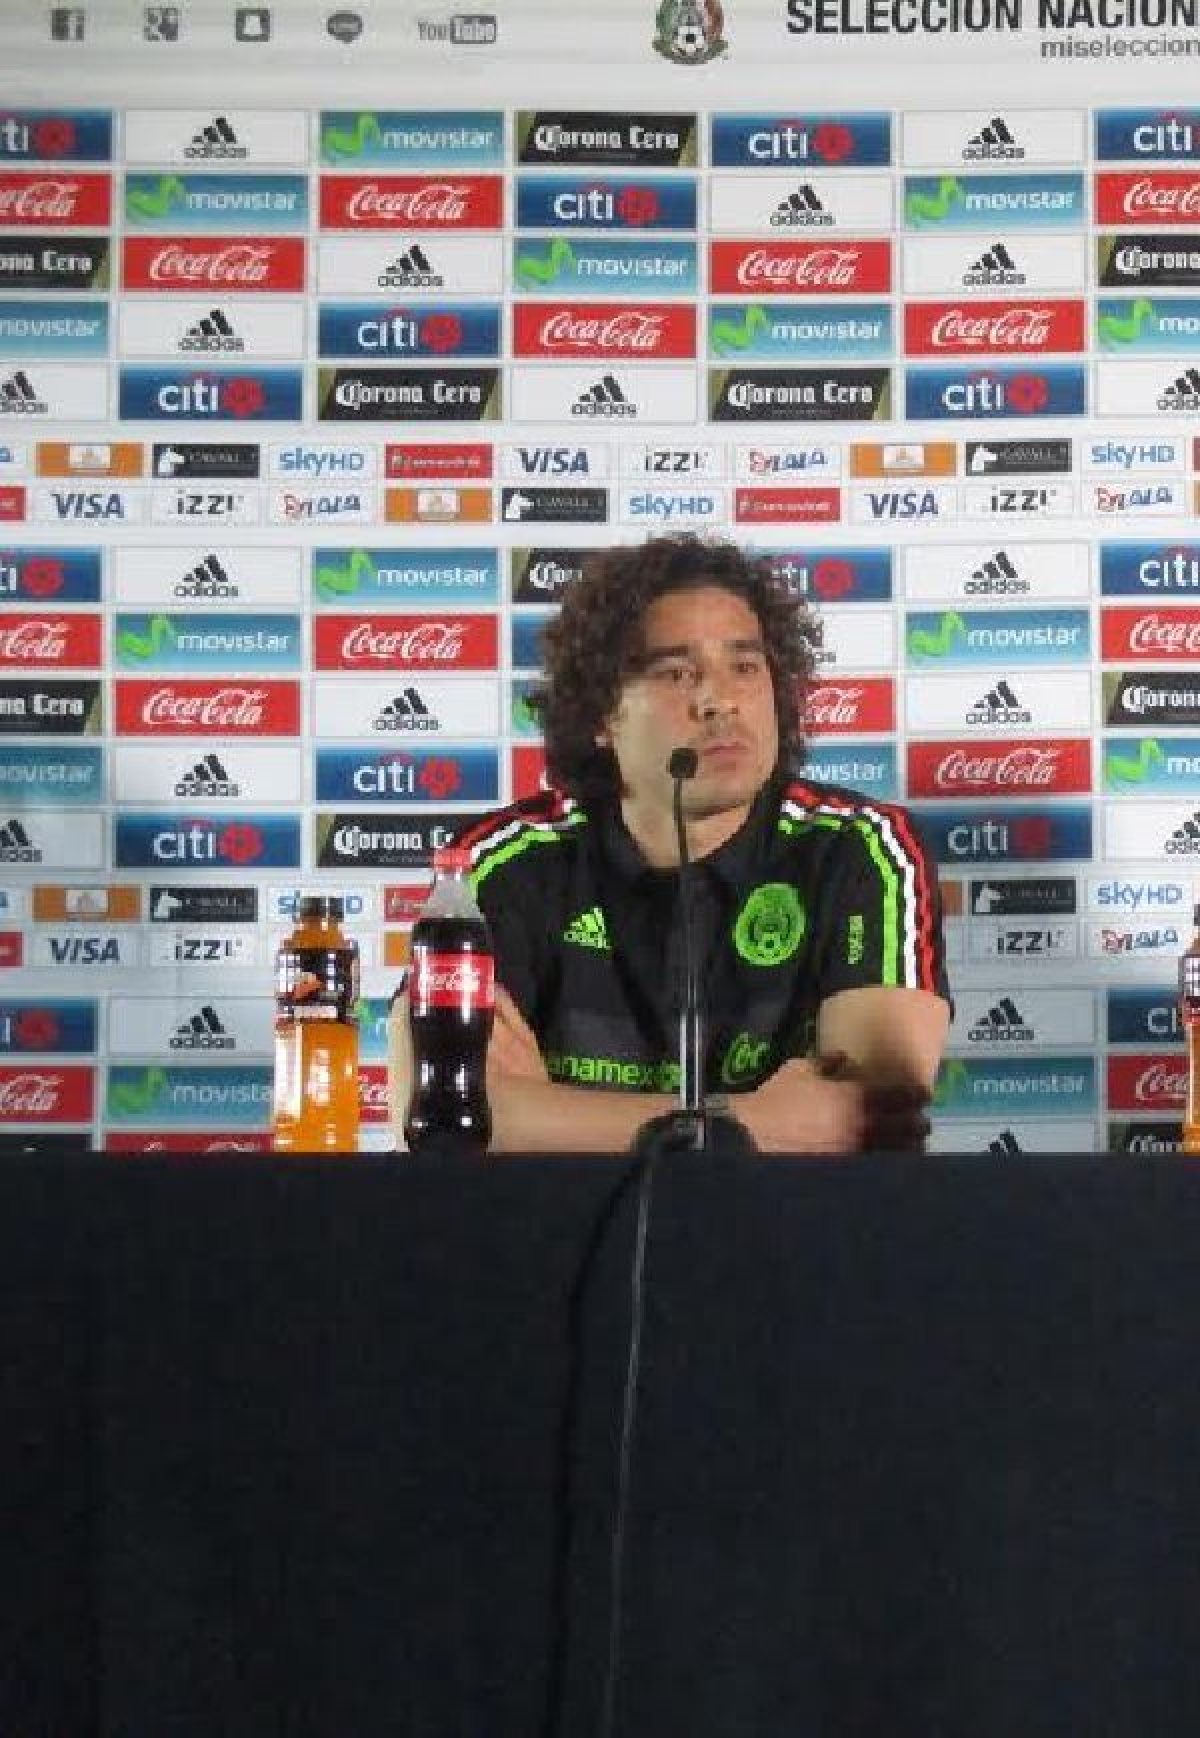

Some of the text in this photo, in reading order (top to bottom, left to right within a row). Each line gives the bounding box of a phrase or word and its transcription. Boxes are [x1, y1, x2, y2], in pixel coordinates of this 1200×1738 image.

[383, 129, 495, 148] movistar
[534, 125, 679, 153] Corona Cero
[183, 145, 249, 159] adidas
[961, 145, 1025, 159] adidas
[187, 191, 297, 210] movistar
[965, 190, 1073, 210] movistar
[770, 213, 836, 226] adidas
[42, 250, 93, 271] Cero
[577, 257, 688, 276] movistar
[377, 274, 444, 287] adidas
[962, 272, 1026, 285] adidas
[772, 319, 881, 339] movistar
[178, 337, 245, 352] adidas
[335, 380, 481, 410] Corona Cero
[728, 380, 873, 410] Corona Cero
[570, 403, 638, 418] adidas
[517, 448, 589, 472] VISA
[52, 493, 124, 518] VISA
[864, 493, 939, 518] VISA
[377, 567, 488, 588] movistar
[964, 580, 1030, 594] adidas
[174, 585, 238, 597] adidas
[177, 632, 288, 652] movistar
[967, 625, 1080, 646] movistar
[34, 694, 83, 716] Cero
[373, 715, 441, 730] adidas
[965, 709, 1031, 724] adidas
[174, 783, 239, 797] adidas
[334, 826, 422, 856] Corona
[49, 938, 121, 965] VISA
[170, 1037, 236, 1049] adidas
[968, 1026, 1034, 1041] adidas
[973, 1075, 1085, 1094] movistar
